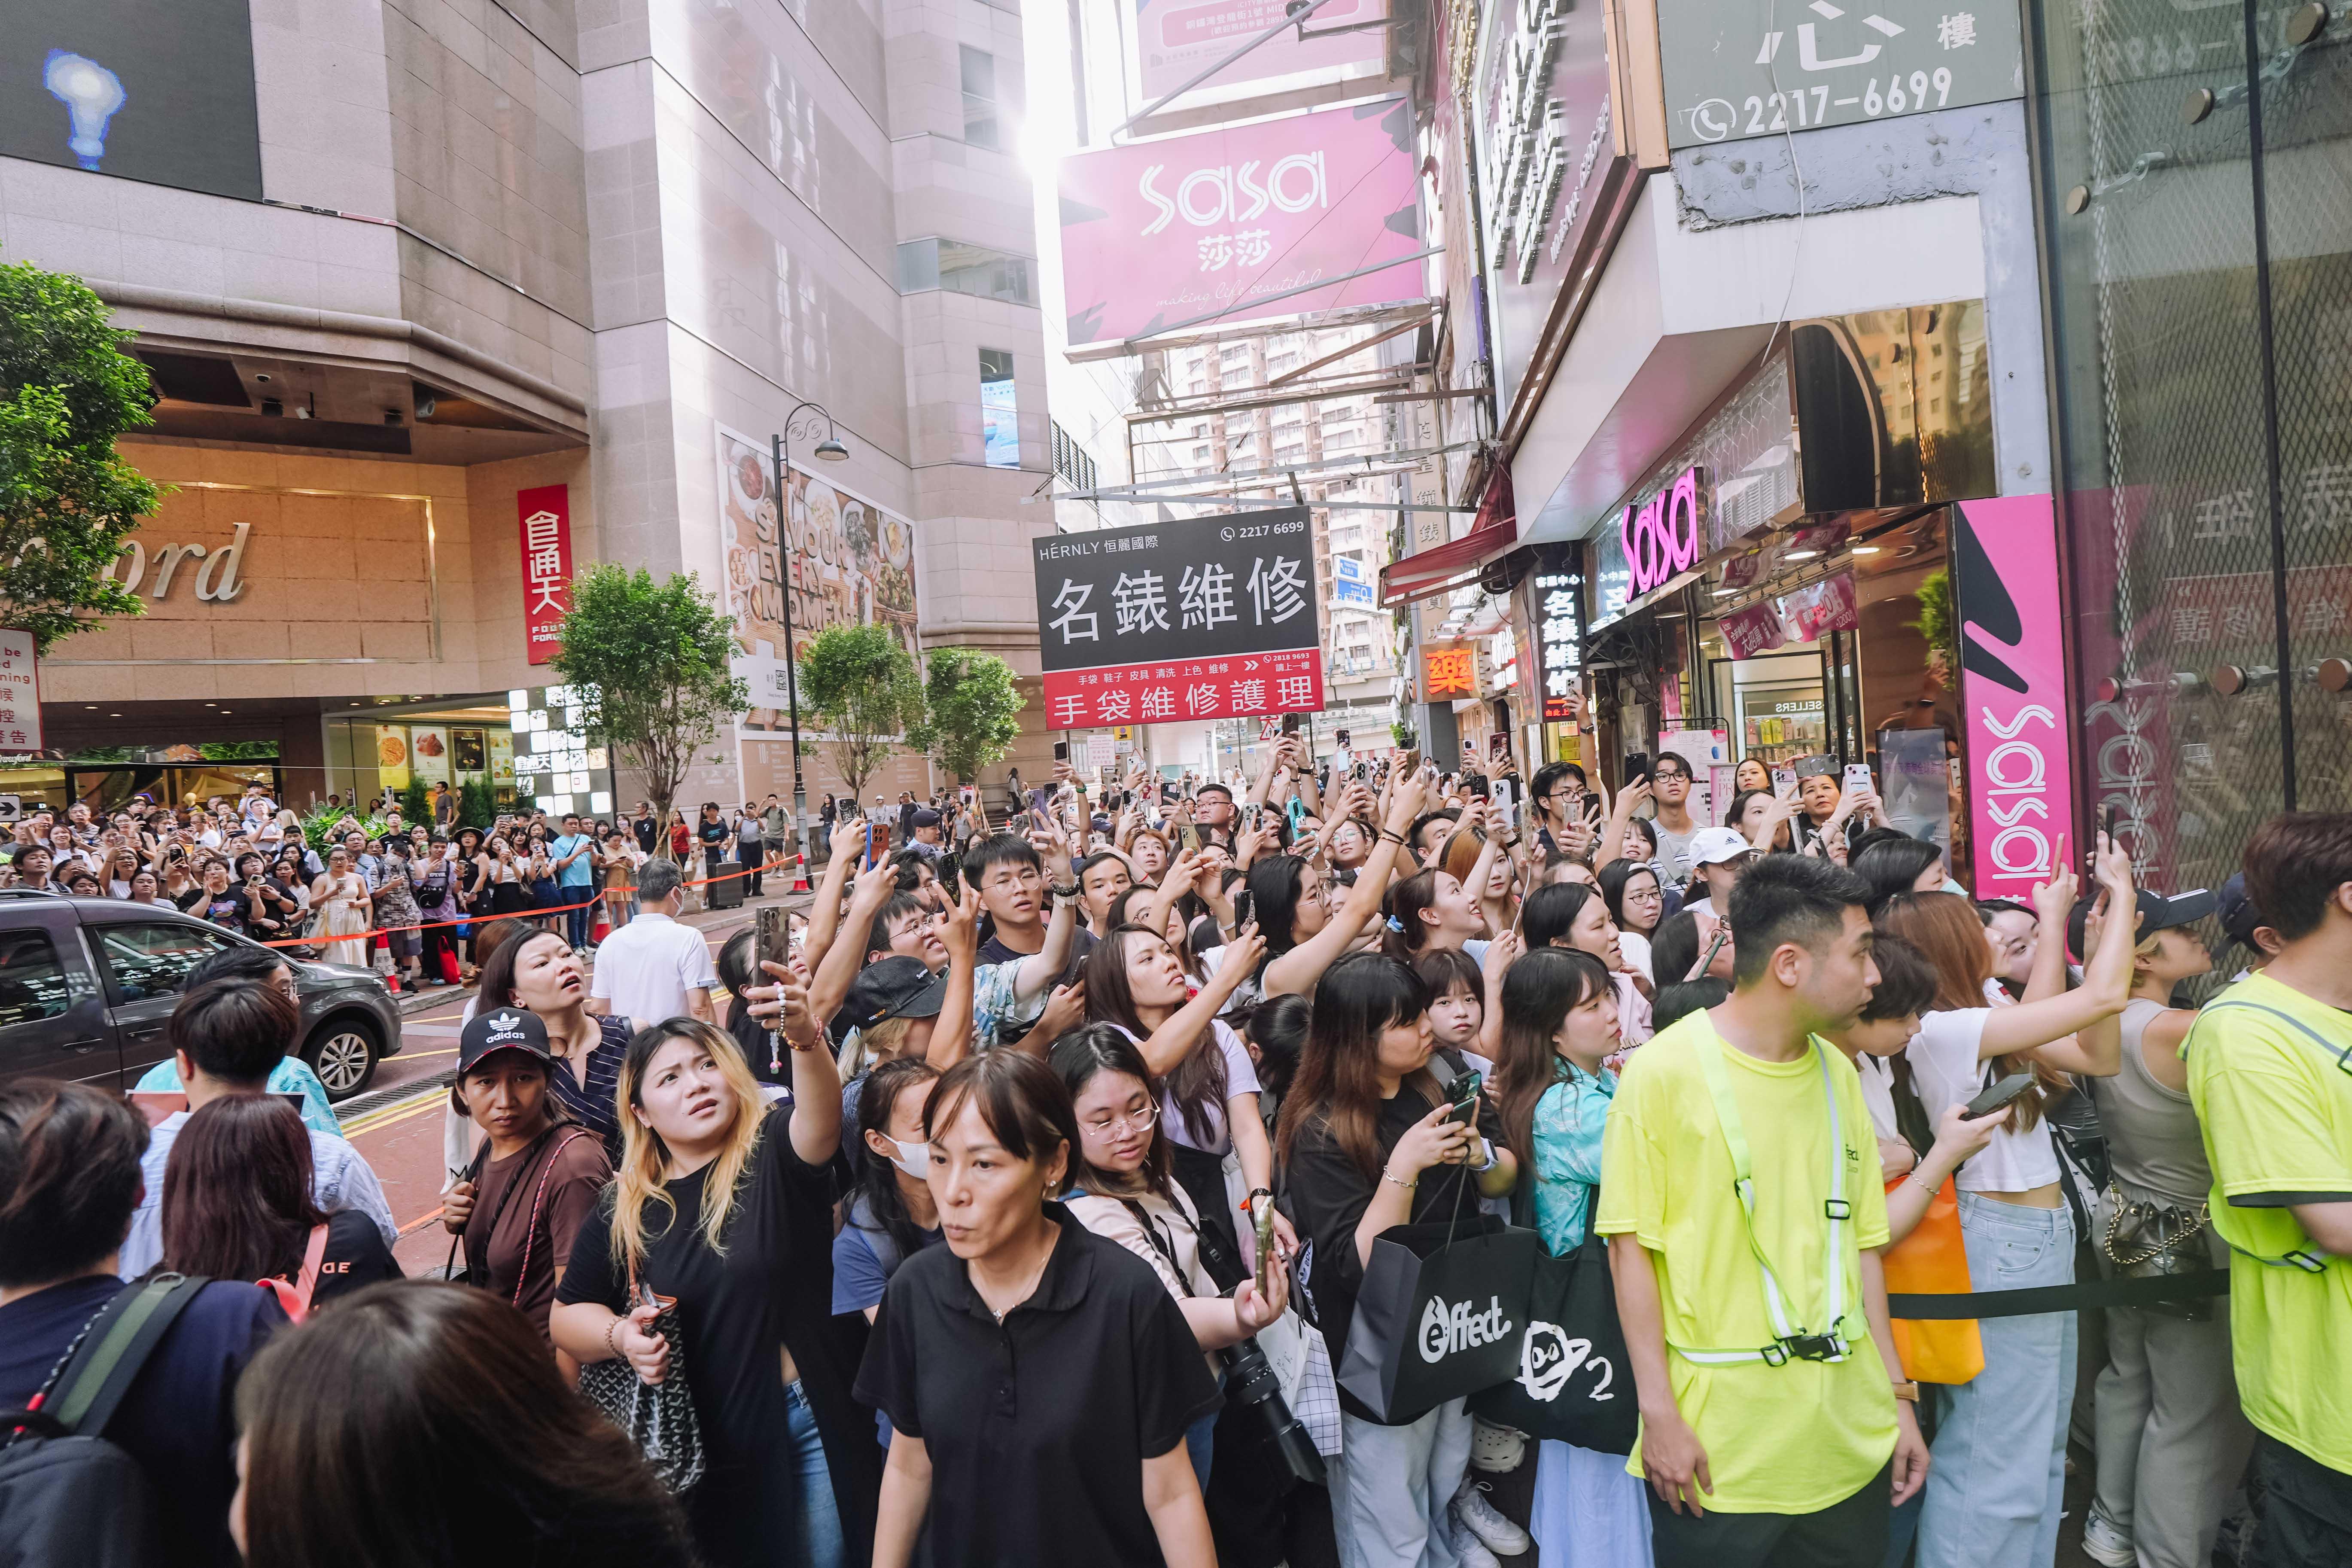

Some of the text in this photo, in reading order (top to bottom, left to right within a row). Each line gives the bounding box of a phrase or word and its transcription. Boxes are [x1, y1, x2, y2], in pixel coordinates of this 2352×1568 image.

[1938, 12, 1976, 50] 樓
[1744, 67, 1952, 134] 2217-6699
[1139, 150, 1327, 237] sasa
[1198, 228, 1272, 272] 莎莎
[1156, 288, 1211, 310] making
[1216, 279, 1244, 306] life
[756, 504, 849, 570] SAVOUR
[1040, 521, 1305, 560] HÉRNLY 恒麗國際 2217 6699
[1622, 467, 1698, 603] sasa
[758, 542, 823, 598] EVERY
[761, 583, 859, 632] MOMENT
[1048, 555, 1307, 644] 名錶維修
[5, 647, 21, 657] be
[1275, 661, 1311, 672] 請上一樓
[1542, 590, 1581, 696] 名錶維修
[1078, 662, 1229, 685] 手袋 鞋子 皮具 清洗 上色 維修
[1426, 648, 1474, 694] 藥
[1053, 675, 1315, 725] 手袋維修護理
[1983, 704, 2055, 880] sasa
[486, 1031, 525, 1044] adidas
[1585, 1356, 1615, 1401] 2
